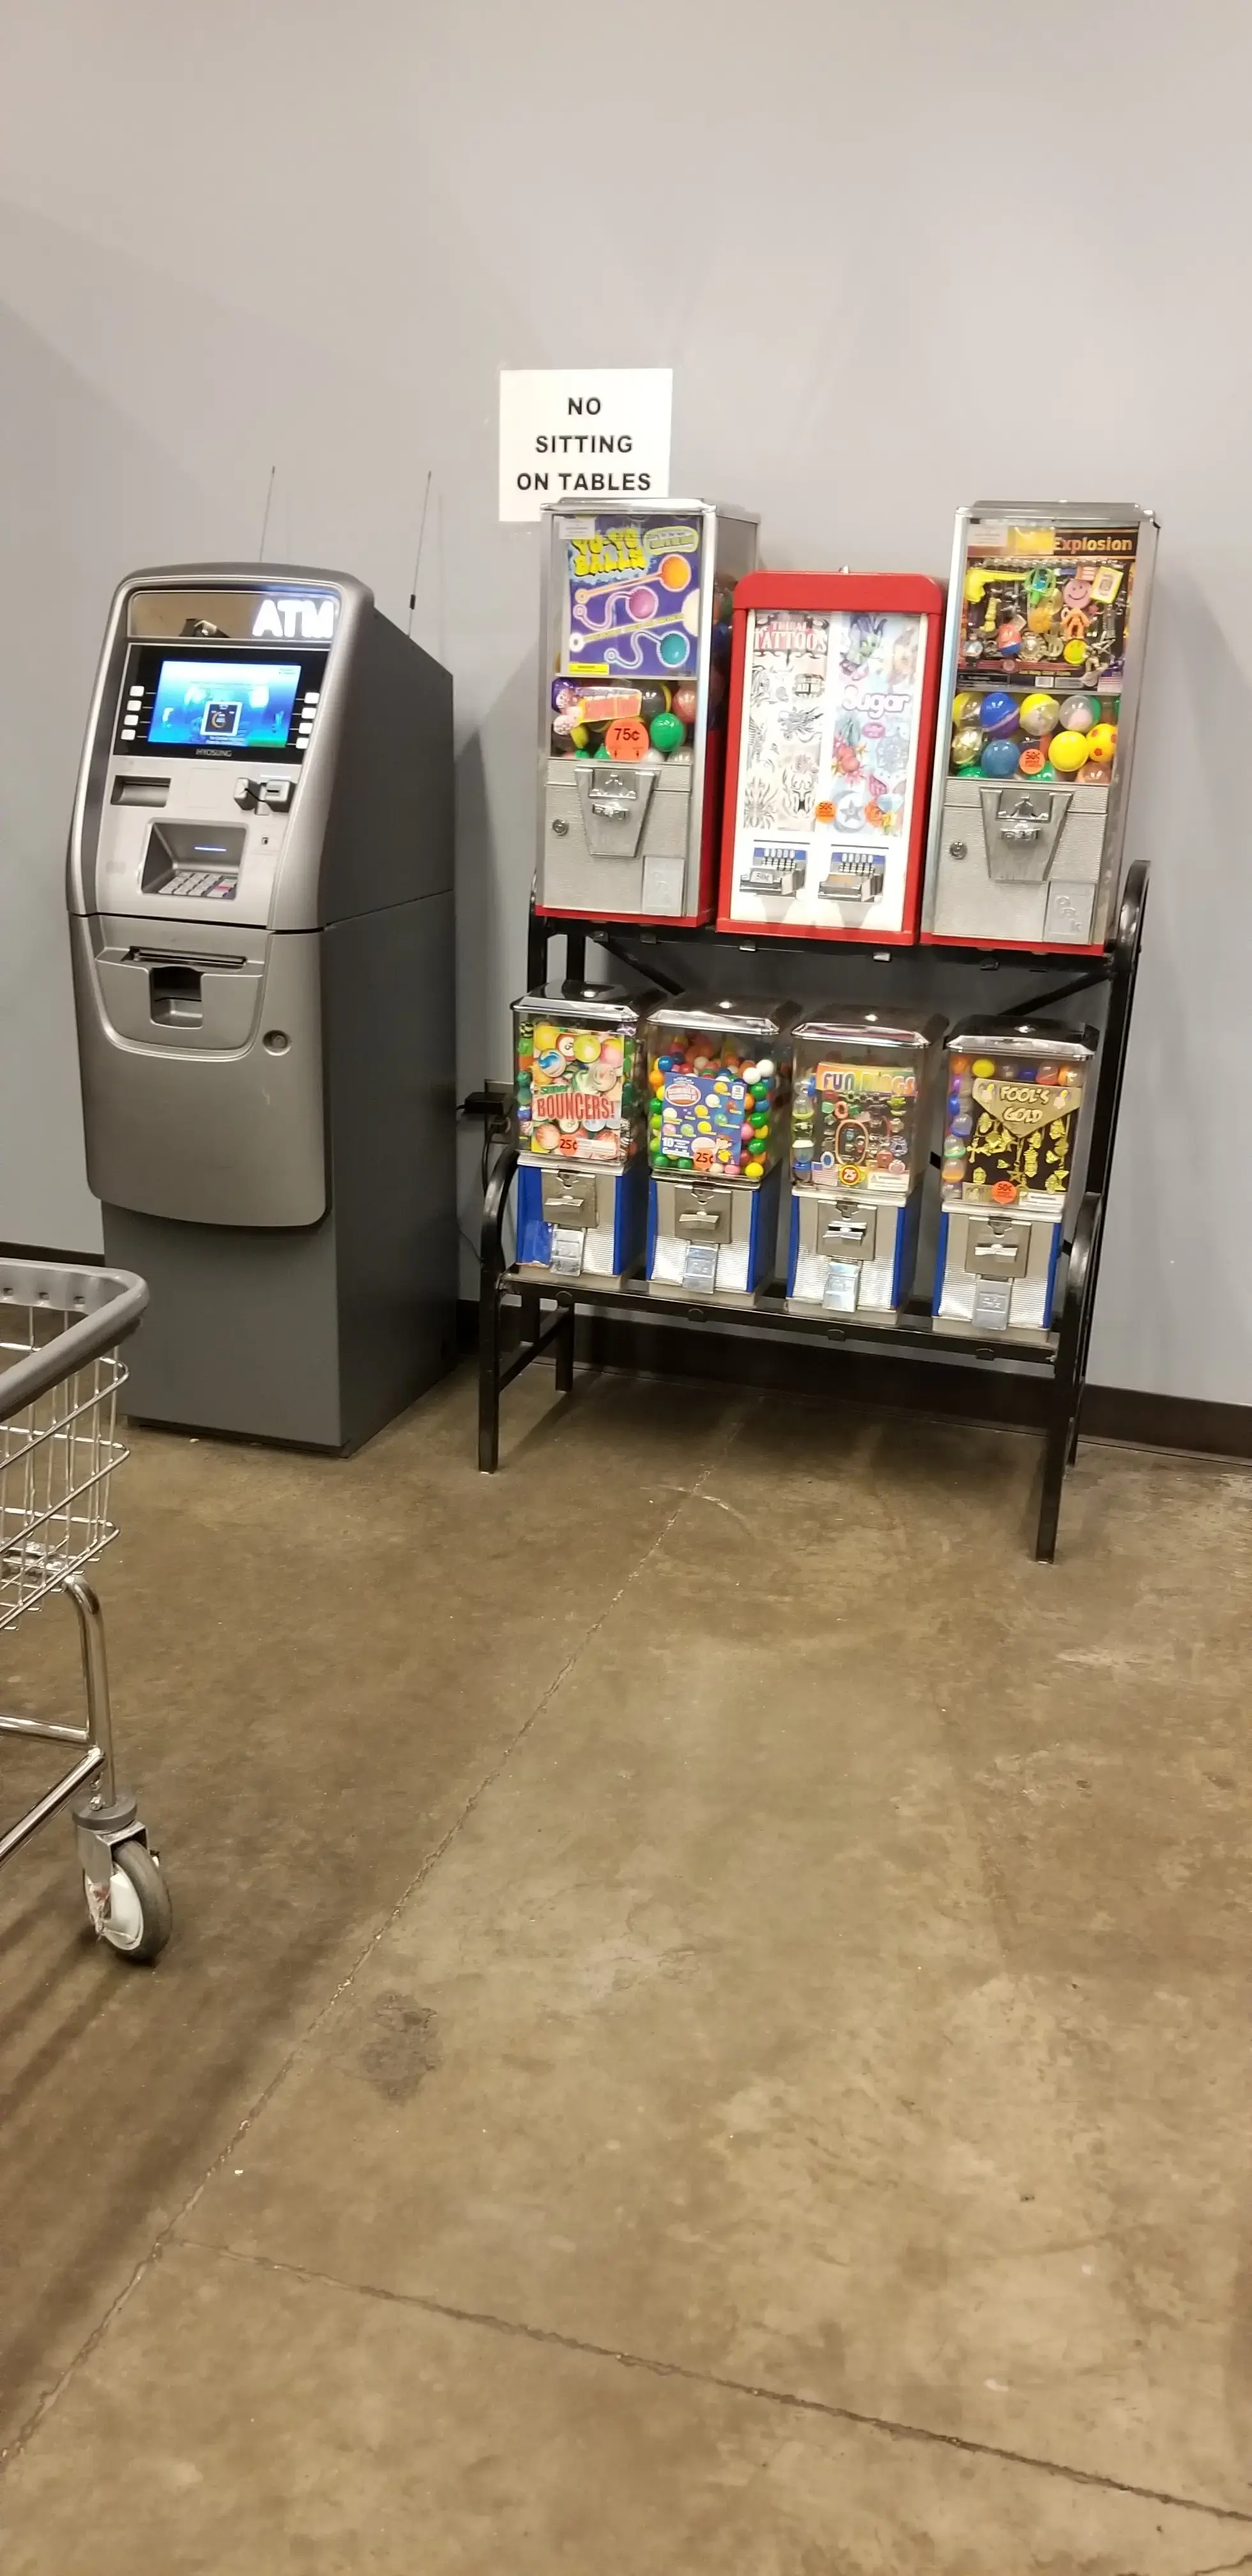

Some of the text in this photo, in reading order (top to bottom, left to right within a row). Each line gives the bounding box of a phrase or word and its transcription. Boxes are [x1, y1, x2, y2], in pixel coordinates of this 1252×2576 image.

[568, 397, 602, 415] NO
[535, 435, 633, 453] SITTING
[517, 473, 651, 491] ON TABLES
[1055, 537, 1133, 554] Explosion
[252, 600, 334, 638] ATM
[754, 628, 828, 652] TATTOOS
[843, 684, 912, 719] Sugar
[195, 748, 233, 757] HYOSUNG
[822, 1071, 856, 1092] FUN
[1000, 1085, 1051, 1105] FOOL'S
[537, 1092, 616, 1120] BOUNCERS!
[1002, 1107, 1044, 1124] GOLD
